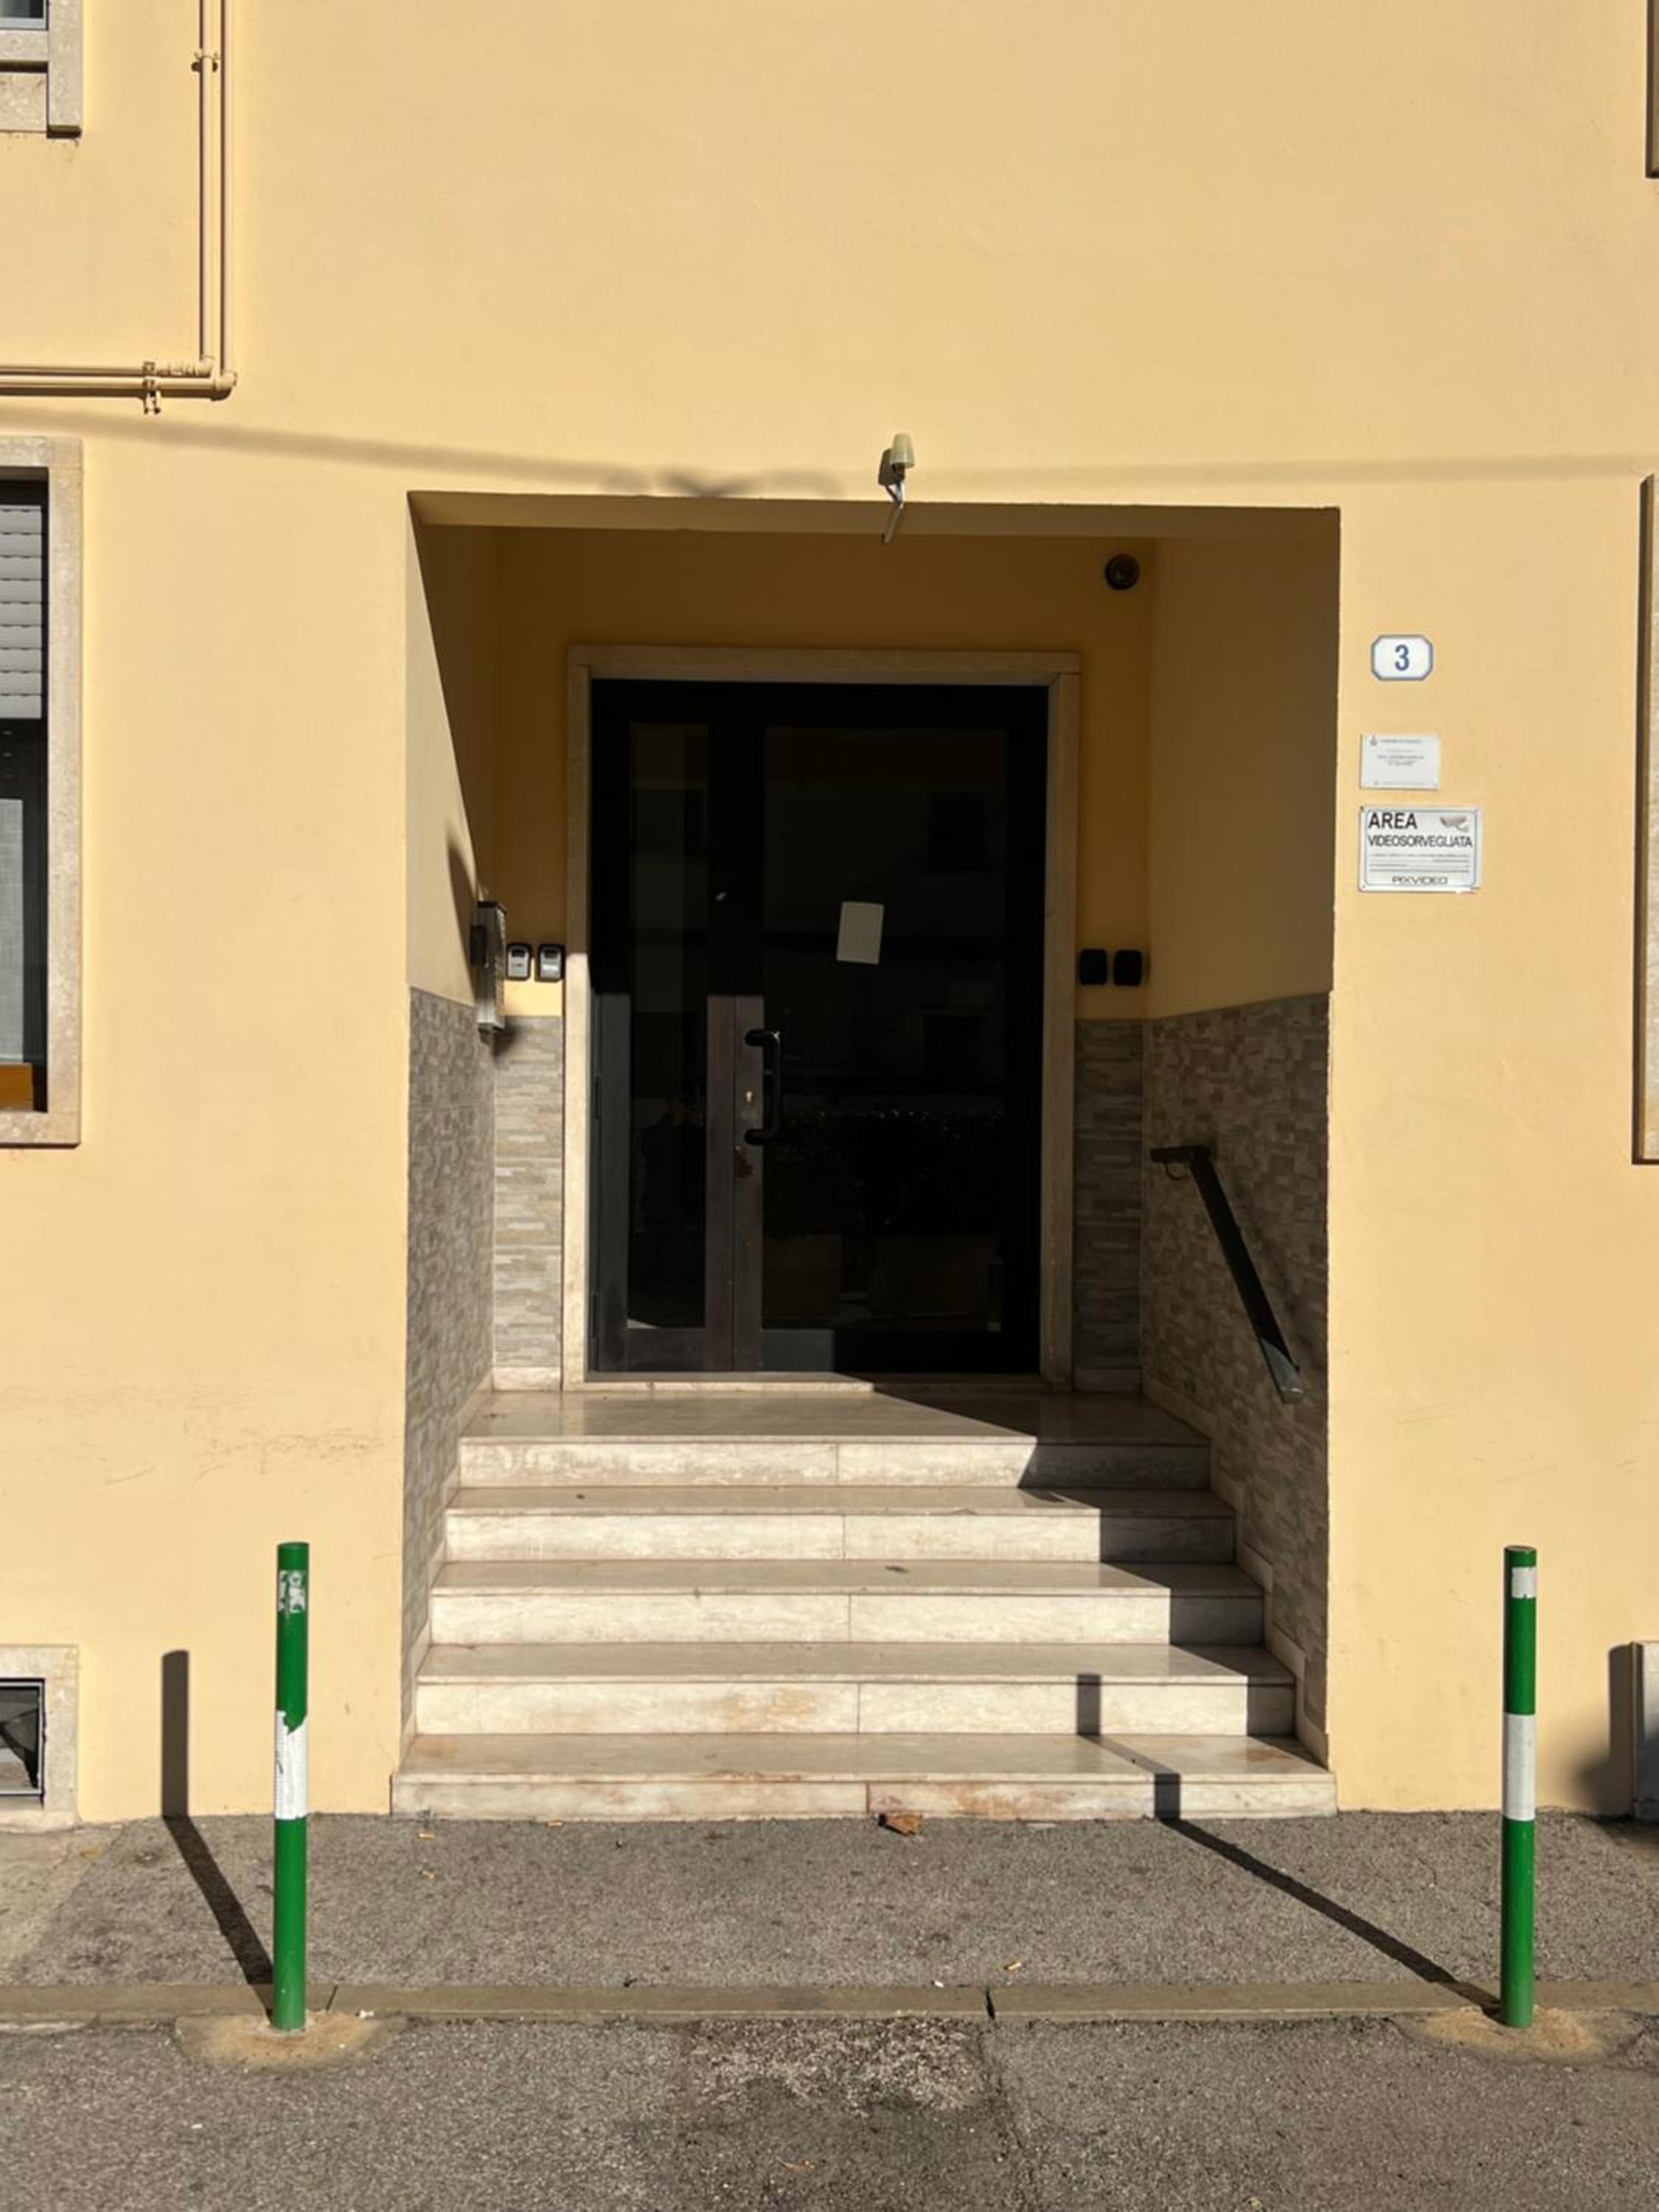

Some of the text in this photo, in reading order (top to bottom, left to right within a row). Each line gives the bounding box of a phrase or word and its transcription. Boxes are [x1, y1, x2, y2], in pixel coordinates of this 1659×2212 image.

[1395, 644, 1410, 671] 3
[1368, 813, 1417, 830] AREA
[1368, 835, 1472, 847] VIDEOSORVEGLIATA
